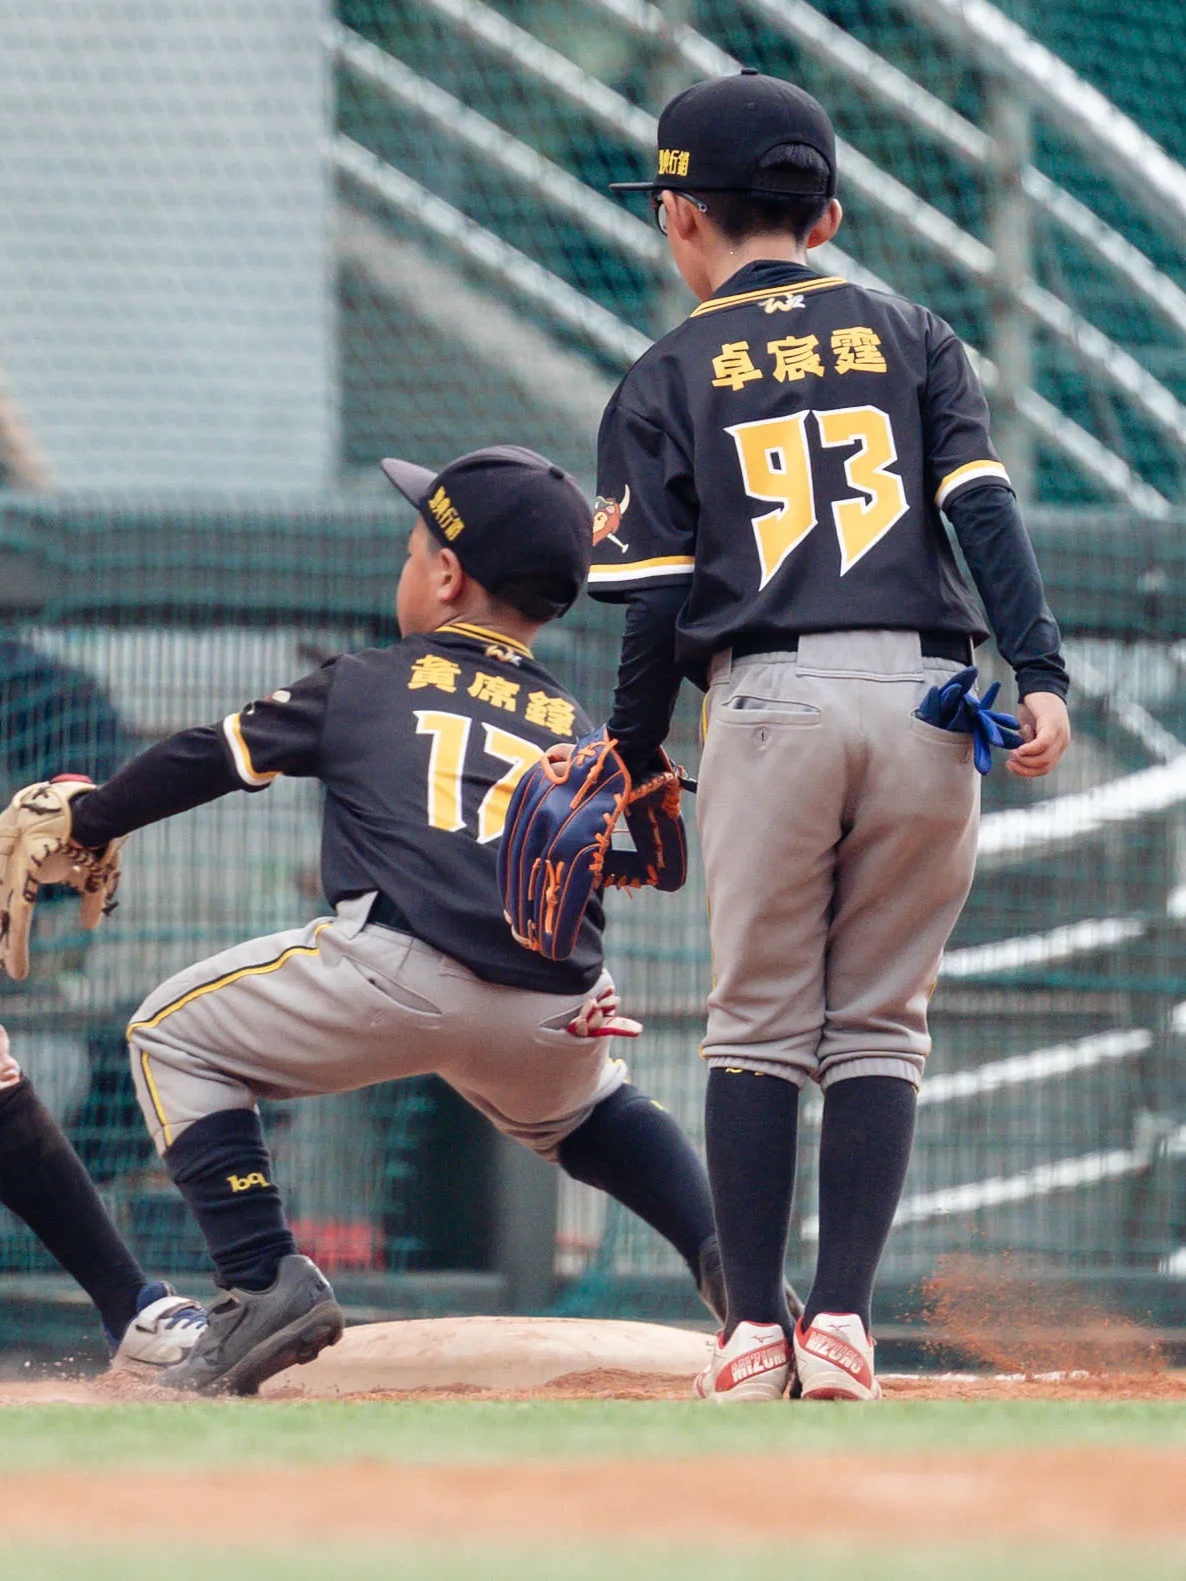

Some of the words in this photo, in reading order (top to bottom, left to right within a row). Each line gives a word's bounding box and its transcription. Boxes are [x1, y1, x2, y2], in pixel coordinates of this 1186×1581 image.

[711, 326, 888, 392] 卓宸霆
[724, 404, 910, 591] 93
[412, 710, 546, 844] 17
